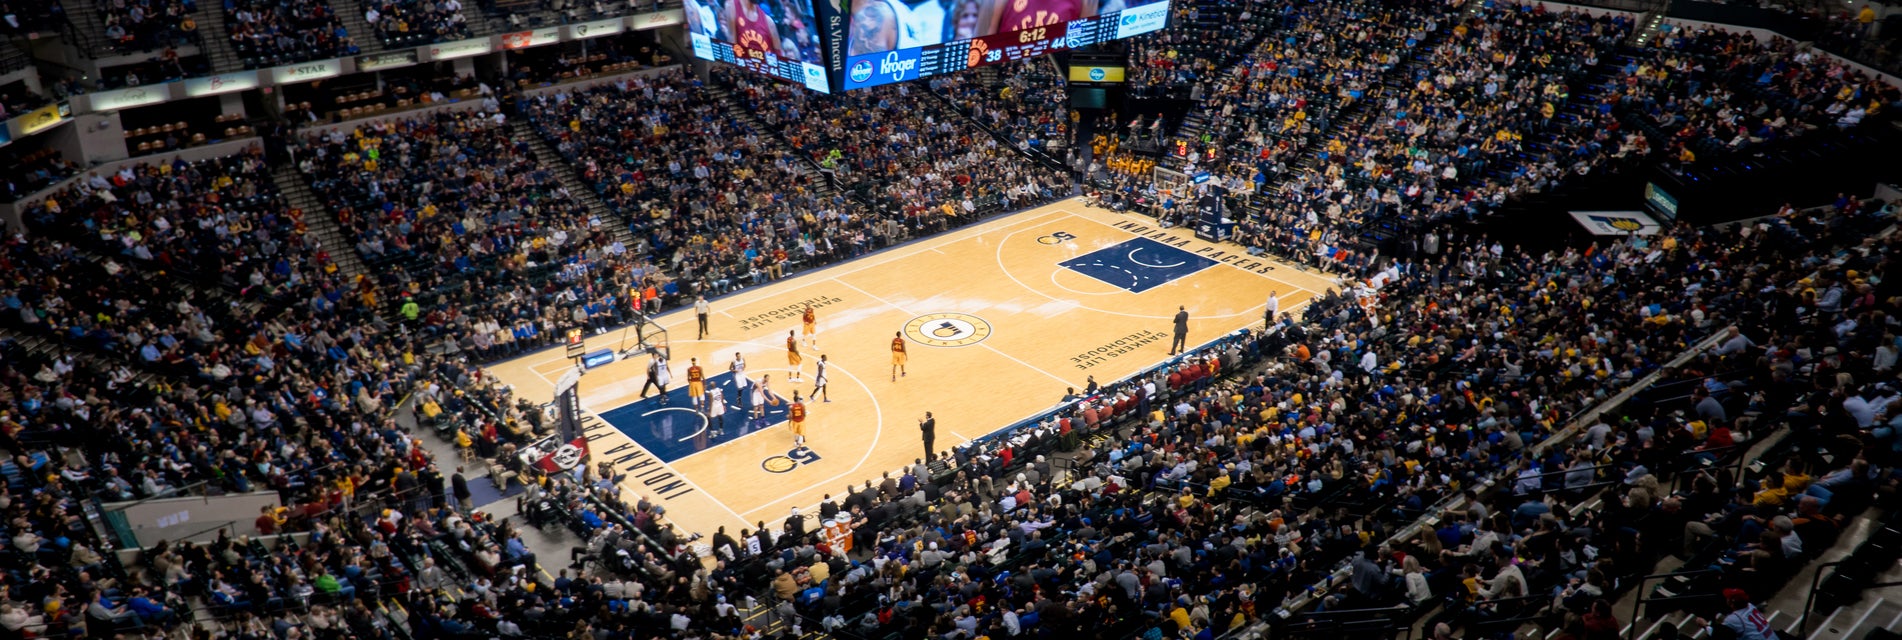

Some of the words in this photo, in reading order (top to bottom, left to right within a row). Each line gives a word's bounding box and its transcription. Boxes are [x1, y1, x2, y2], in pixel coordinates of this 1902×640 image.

[830, 16, 842, 30] St.
[1019, 28, 1046, 43] 6:12
[1051, 37, 1066, 49] 44
[832, 29, 843, 72] Vincent
[986, 49, 1002, 62] 38
[298, 64, 326, 74] STAR
[880, 51, 917, 82] Kroger
[1112, 220, 1191, 248] INDIANA
[1195, 246, 1276, 274] PACERS
[776, 297, 842, 320] BANERS
[740, 318, 773, 331] LIFE
[1070, 330, 1152, 364] FIELDHOUSE
[1107, 332, 1168, 358] BANKERS
[1075, 356, 1108, 370] LIFE
[604, 442, 694, 500] INDIANA
